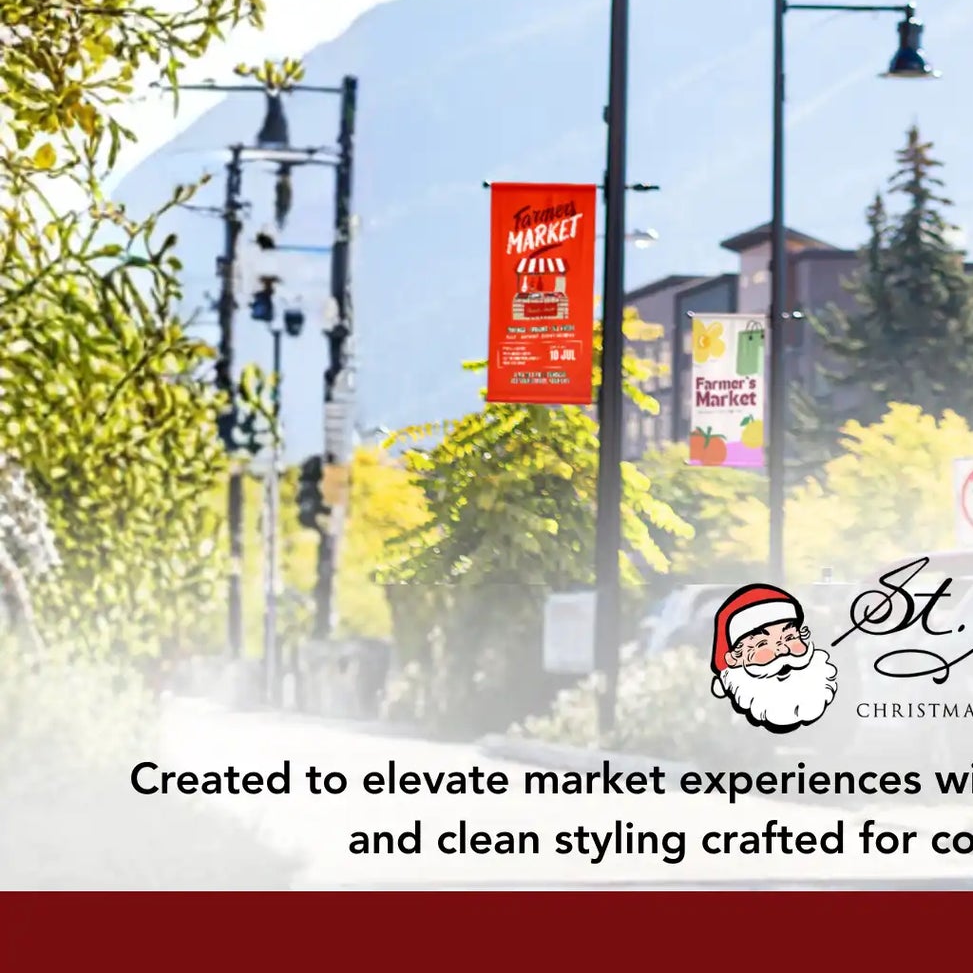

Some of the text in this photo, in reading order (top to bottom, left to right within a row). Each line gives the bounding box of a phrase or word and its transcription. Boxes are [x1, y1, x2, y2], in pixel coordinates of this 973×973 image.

[506, 213, 583, 255] MARKET
[550, 349, 560, 361] 10
[560, 349, 576, 361] JUL
[695, 376, 757, 390] Farmer's
[695, 390, 757, 407] Market
